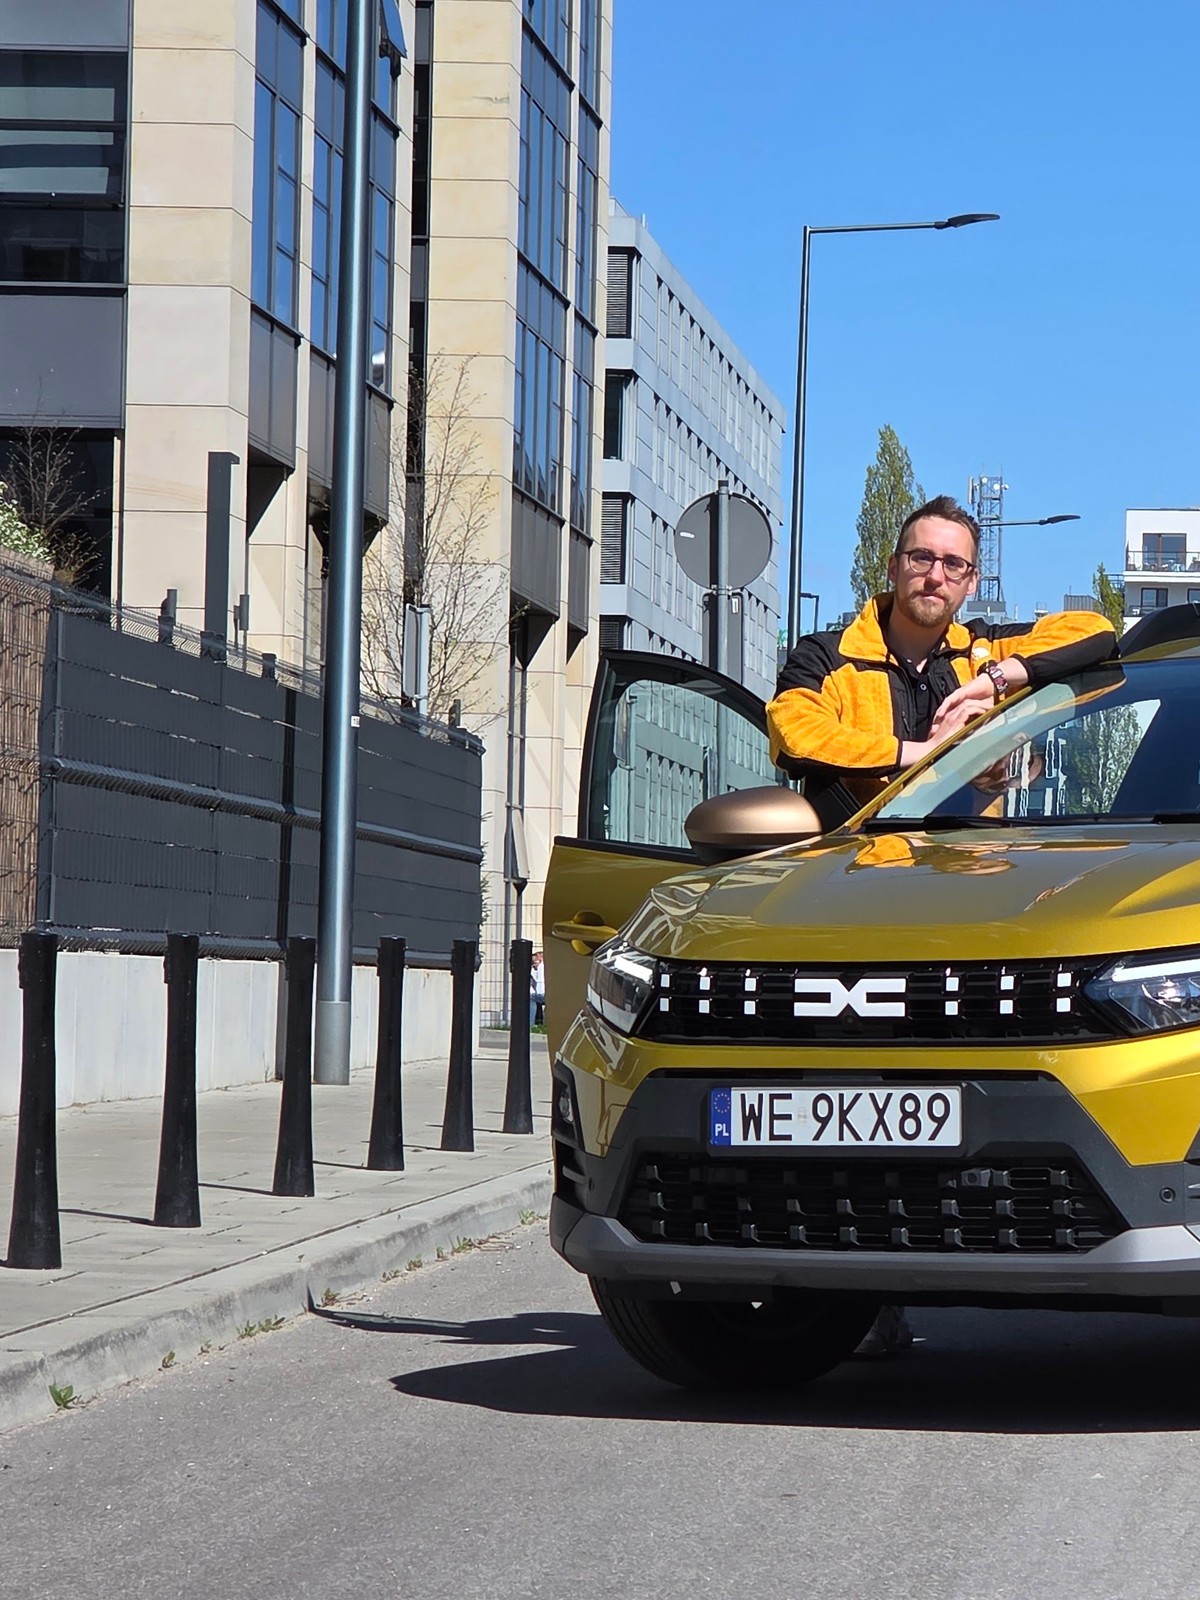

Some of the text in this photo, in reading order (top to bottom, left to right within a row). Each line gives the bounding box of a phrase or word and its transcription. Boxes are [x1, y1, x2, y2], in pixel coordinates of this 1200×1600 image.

[715, 1124, 729, 1136] PL
[740, 1093, 951, 1141] WE 9KX89
